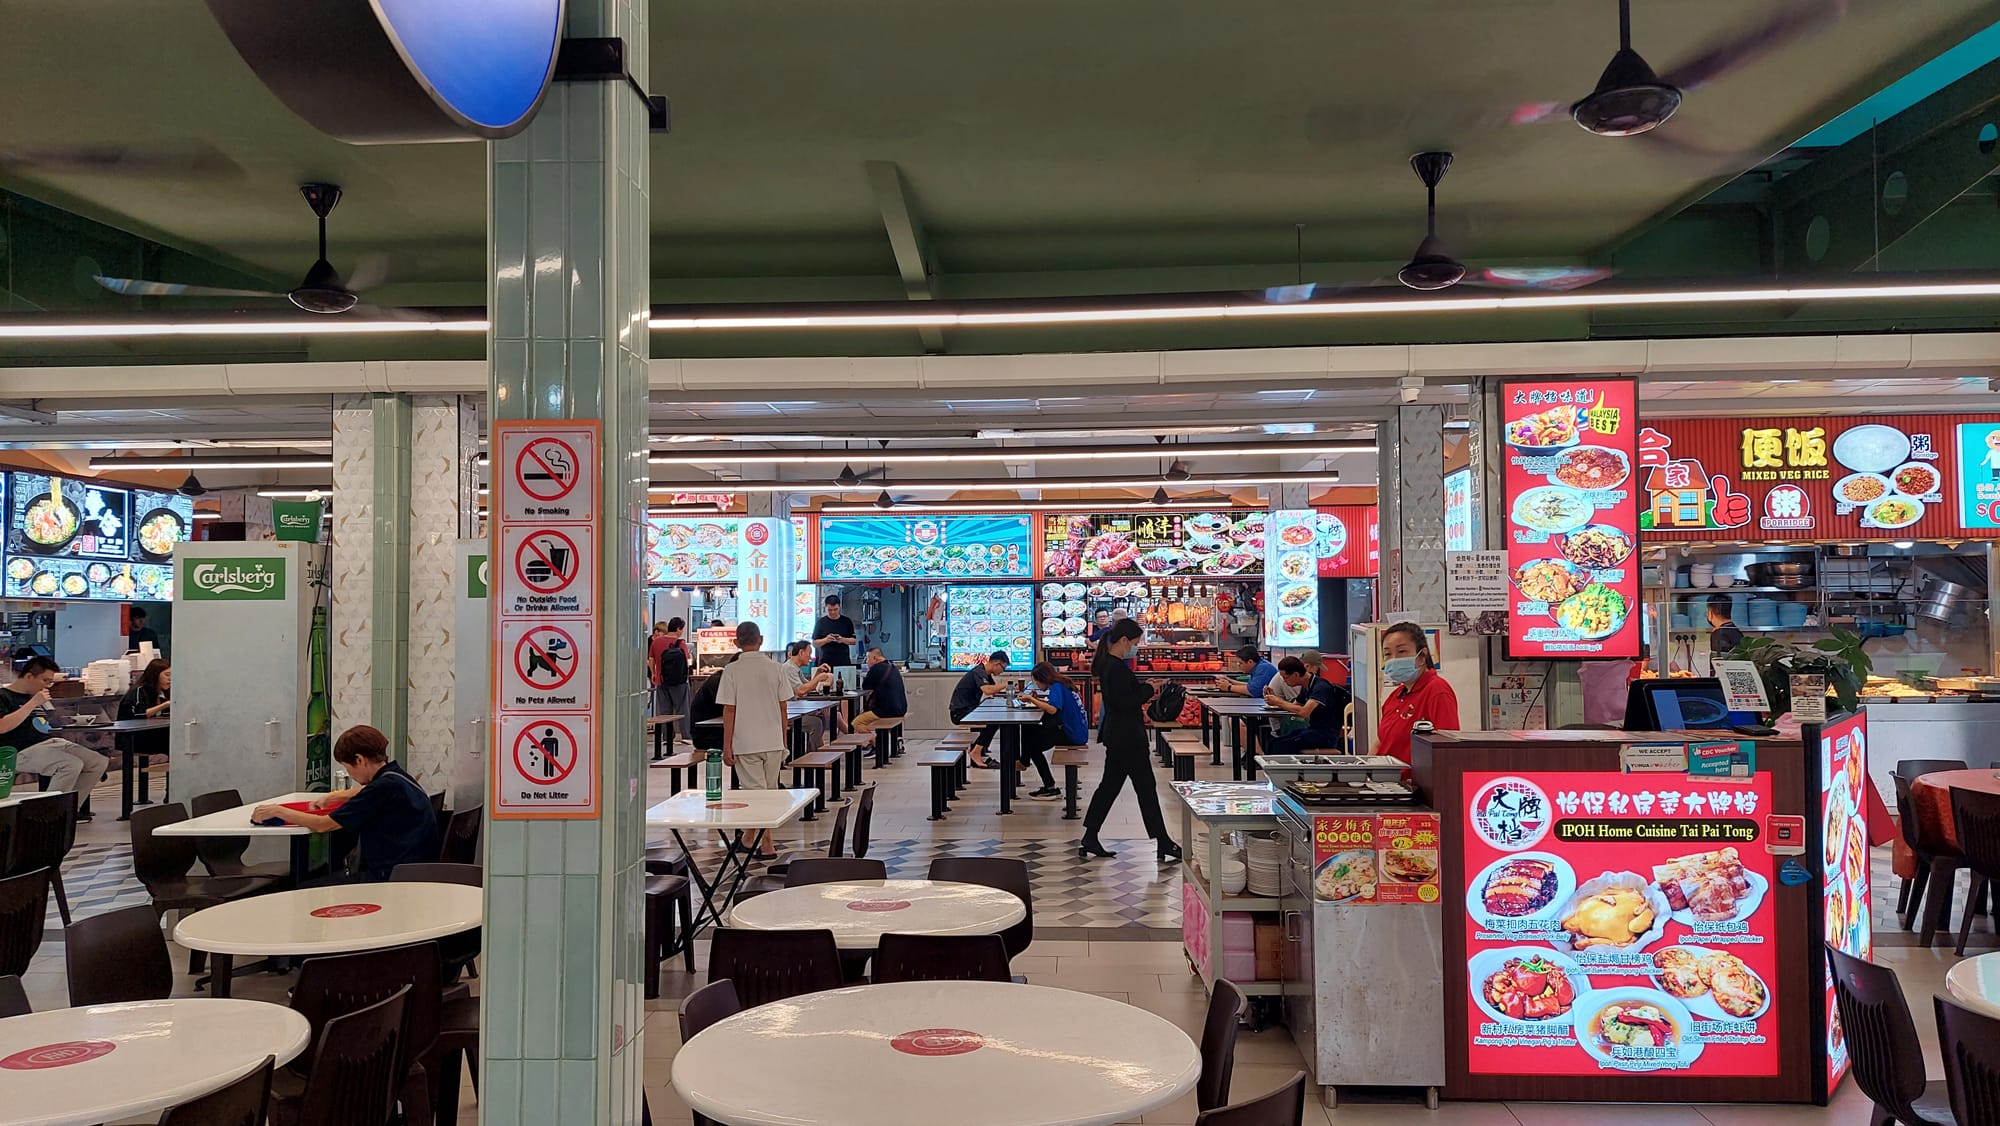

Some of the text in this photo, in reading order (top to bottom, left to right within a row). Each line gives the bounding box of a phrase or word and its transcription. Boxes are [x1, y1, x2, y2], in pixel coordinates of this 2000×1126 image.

[1590, 409, 1618, 421] MALAYSIA
[1590, 421, 1617, 433] BEST
[1741, 427, 1828, 468] 便饭
[1912, 435, 1930, 452] 粥
[1667, 465, 1689, 487] 家
[1742, 469, 1830, 481] MIXED VEG RICE
[1770, 489, 1801, 518] 粥
[525, 507, 570, 516] No Smoking
[280, 514, 310, 526] Carlsberg
[1765, 519, 1809, 528] PORRIDGE
[193, 563, 276, 594] Carlsberg
[517, 596, 577, 604] No Outside Food
[514, 604, 580, 612] Or Drinks Allowed
[547, 696, 577, 704] Allowed
[1701, 747, 1737, 757] CDC Voucher
[1701, 760, 1729, 769] Accepted
[521, 792, 569, 800] Do Not Litter
[1556, 790, 1759, 816] 怡保私房菜大牌档
[1562, 823, 1754, 840] IPOH Home Cuisine Tai Pai Tong
[1485, 919, 1562, 930] 梅菜扣肉五花肉
[1693, 921, 1748, 932] 怡保纸包鸡
[1476, 932, 1505, 940] Preserved
[1506, 933, 1517, 941] Veg
[1556, 933, 1571, 941] Belly
[1694, 936, 1711, 944] Paper
[1712, 936, 1738, 944] Wrapped
[1612, 968, 1639, 976] Kampong
[1481, 1023, 1569, 1035] 新村私房菜猪脚醋
[1690, 1021, 1755, 1033] 旧街场炸虾饼
[1475, 1038, 1502, 1046] Kampong
[1503, 1038, 1518, 1046] Style
[1519, 1038, 1541, 1046] Vinegar
[1682, 1034, 1692, 1042] Old
[1728, 1035, 1748, 1044] Shrimp
[1600, 1060, 1612, 1068] Ipoh
[1661, 1060, 1675, 1069] Yong
